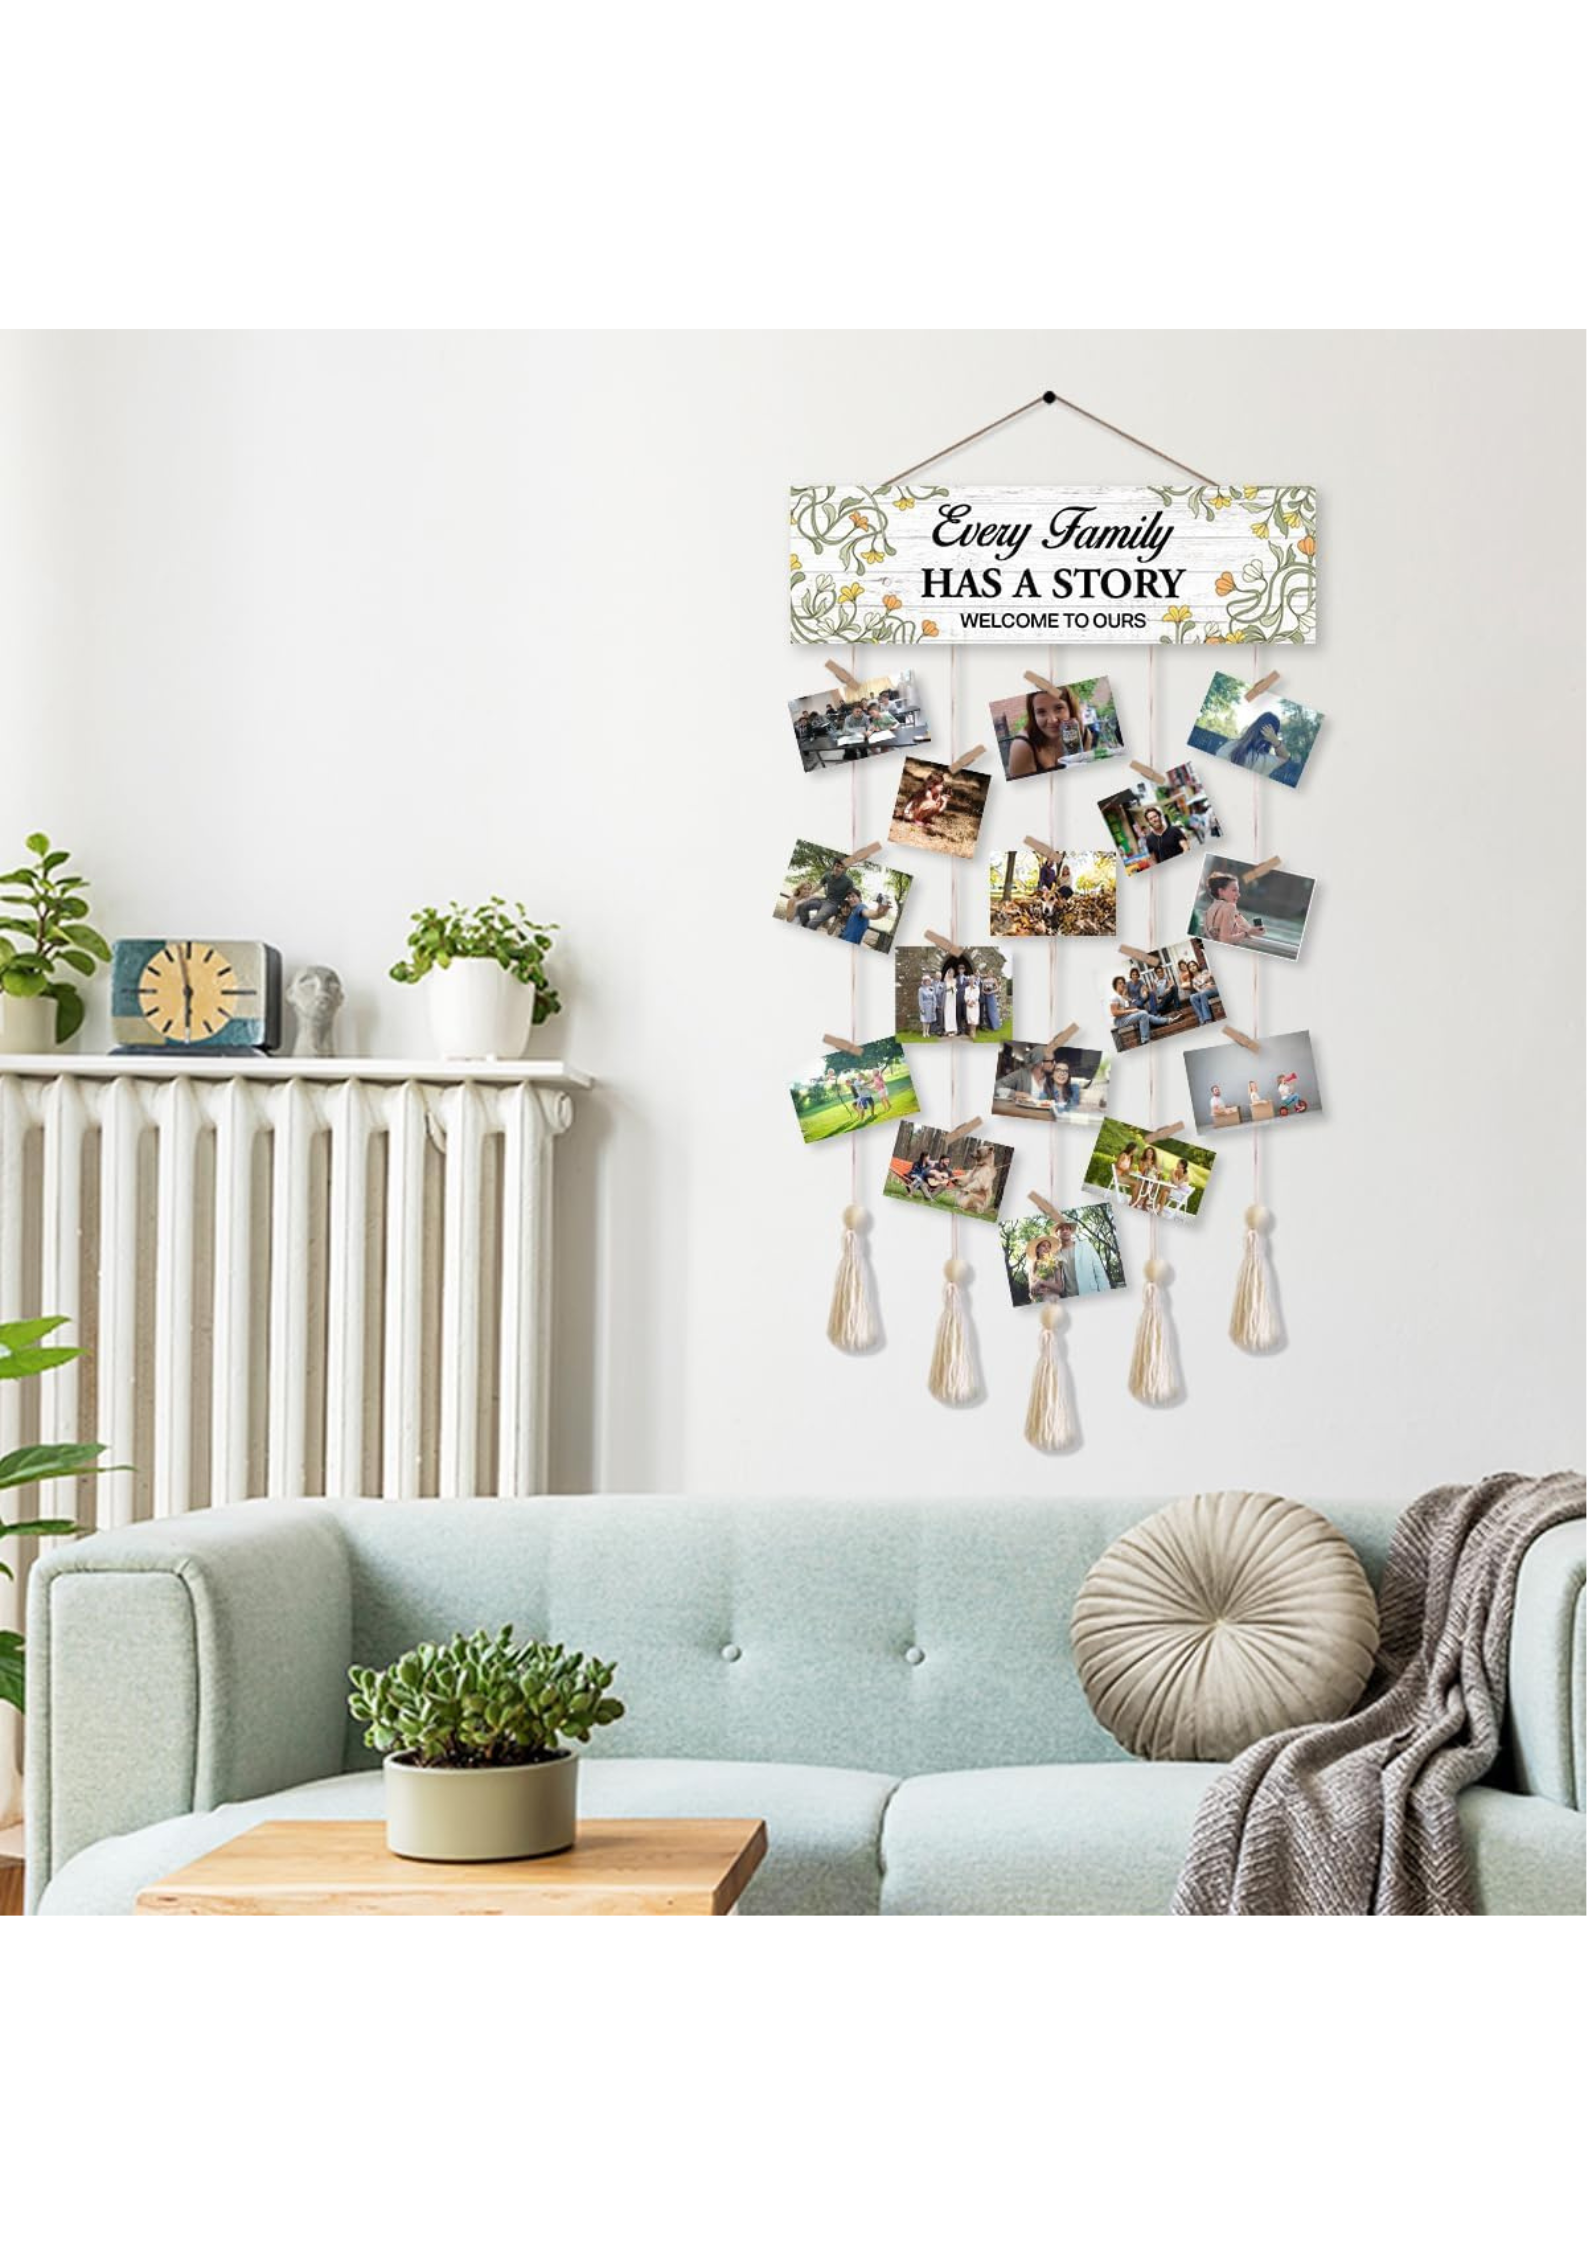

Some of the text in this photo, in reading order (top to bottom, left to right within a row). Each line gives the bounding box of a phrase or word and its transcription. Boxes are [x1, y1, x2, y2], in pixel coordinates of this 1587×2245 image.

[932, 503, 1175, 564] Every Family
[921, 567, 1187, 599] HAS A STORY
[960, 612, 1147, 629] WELCOME TO OURS
